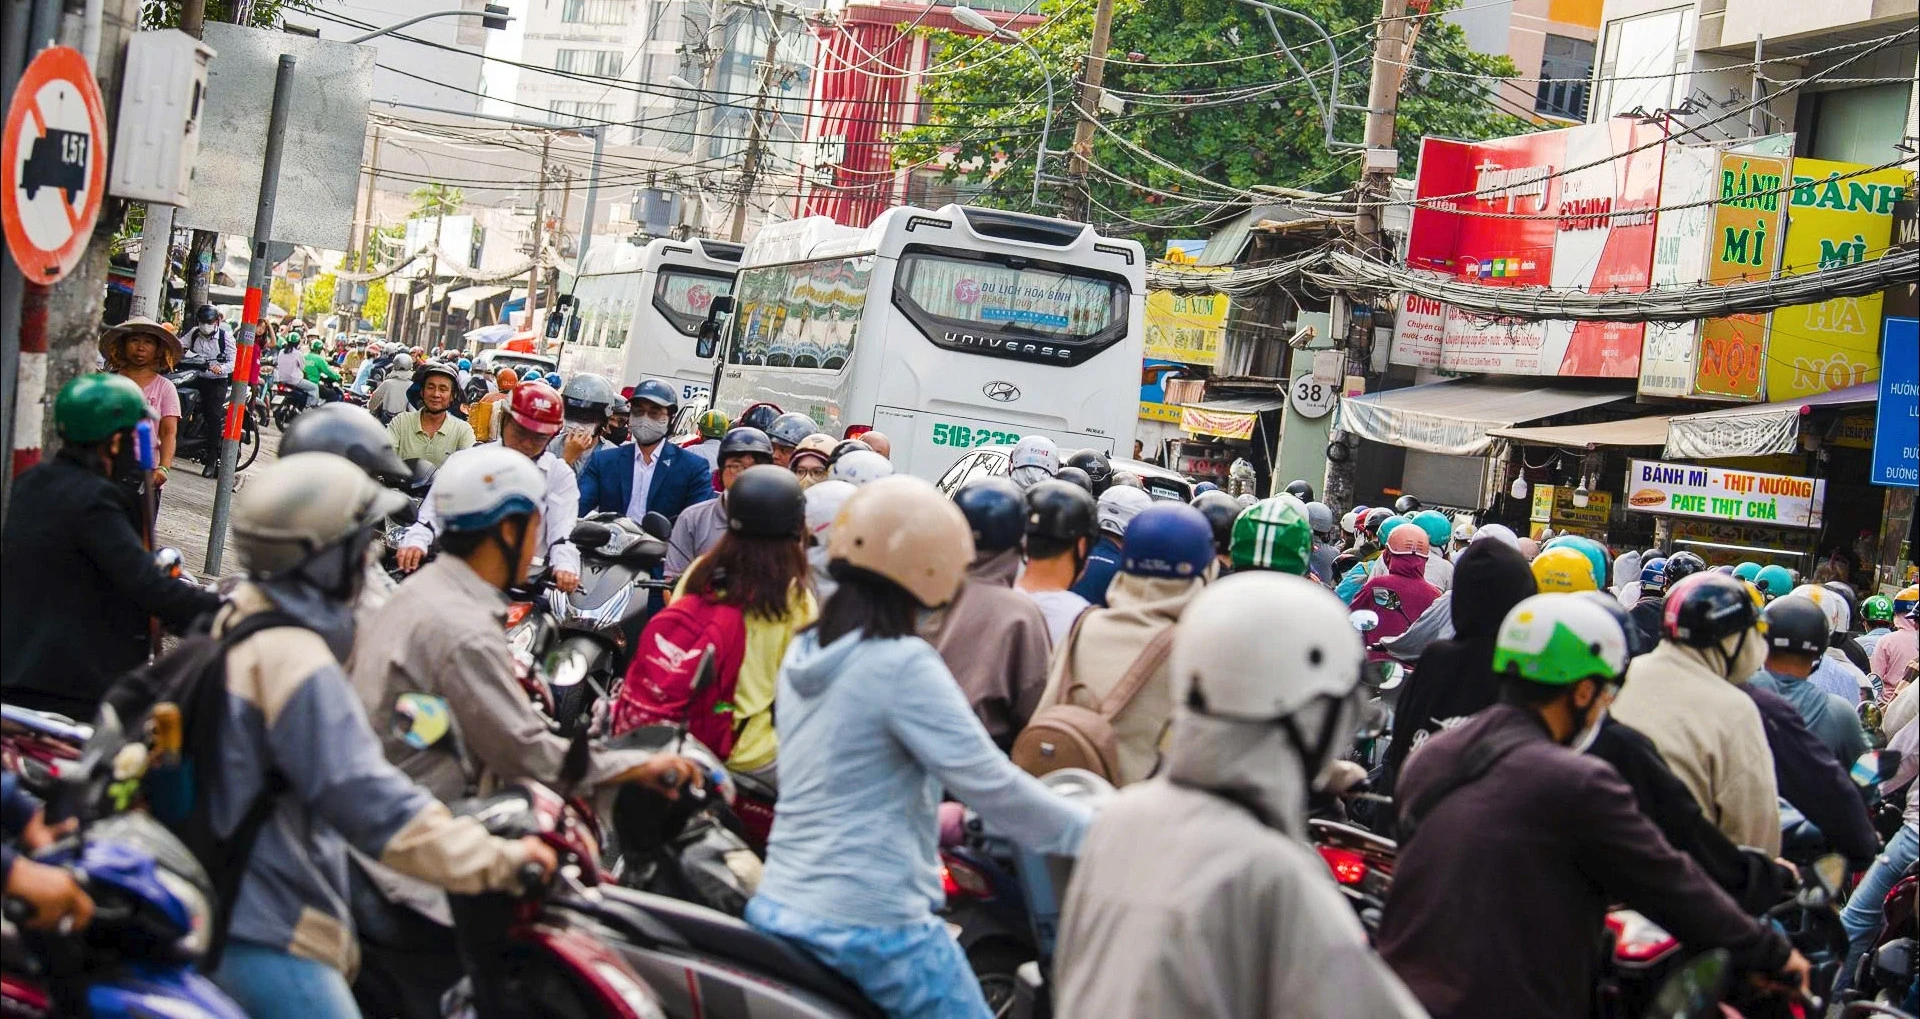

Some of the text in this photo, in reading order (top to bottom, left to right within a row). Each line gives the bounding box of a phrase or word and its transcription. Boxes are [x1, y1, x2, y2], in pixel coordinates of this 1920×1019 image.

[1721, 161, 1781, 212] BÁNH
[1791, 172, 1903, 215] BÁNH
[1722, 219, 1766, 267] MÌ
[1818, 235, 1869, 269] MÌ
[982, 283, 995, 292] DU
[945, 332, 1071, 358] UNIVERSE
[1702, 331, 1760, 387] NỘI
[1298, 384, 1321, 402] 38
[1642, 463, 1684, 485] BÁNH
[1689, 468, 1708, 487] MÌ
[1723, 473, 1755, 495] THỊT
[1758, 475, 1813, 498] NƯỚNG
[1886, 464, 1918, 481] ĐƯỜNG
[1671, 493, 1777, 520] PATE THỊT CHẢ
